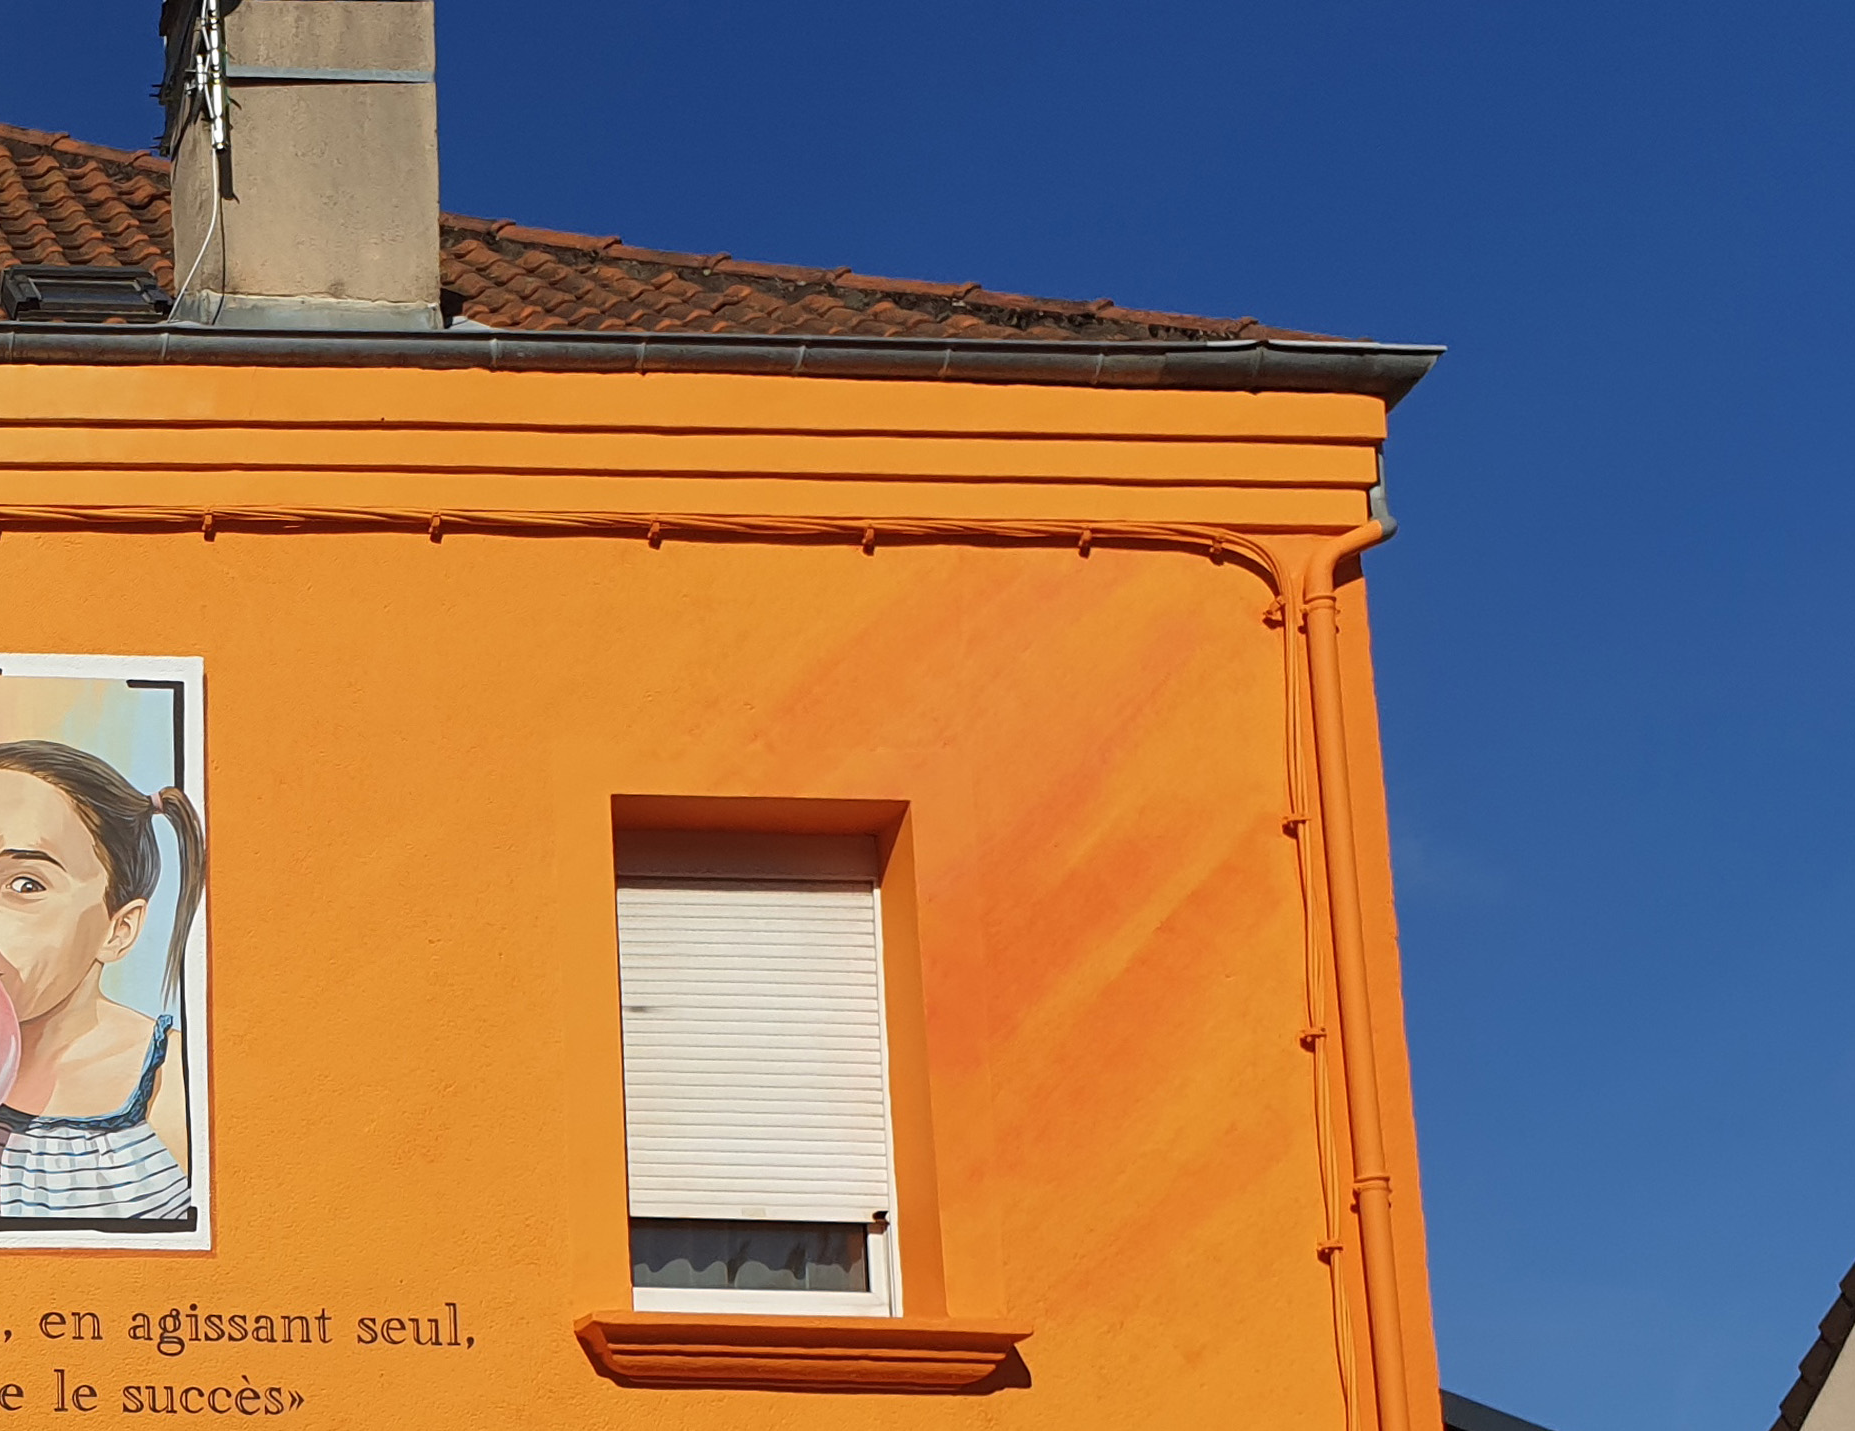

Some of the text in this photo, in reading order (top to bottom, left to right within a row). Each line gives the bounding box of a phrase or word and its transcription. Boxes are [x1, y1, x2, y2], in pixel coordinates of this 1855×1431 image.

[38, 1309, 103, 1341] en
[127, 1303, 333, 1356] agissant
[356, 1302, 475, 1350] seul,
[53, 1369, 98, 1412] le
[122, 1375, 305, 1416] succès»
